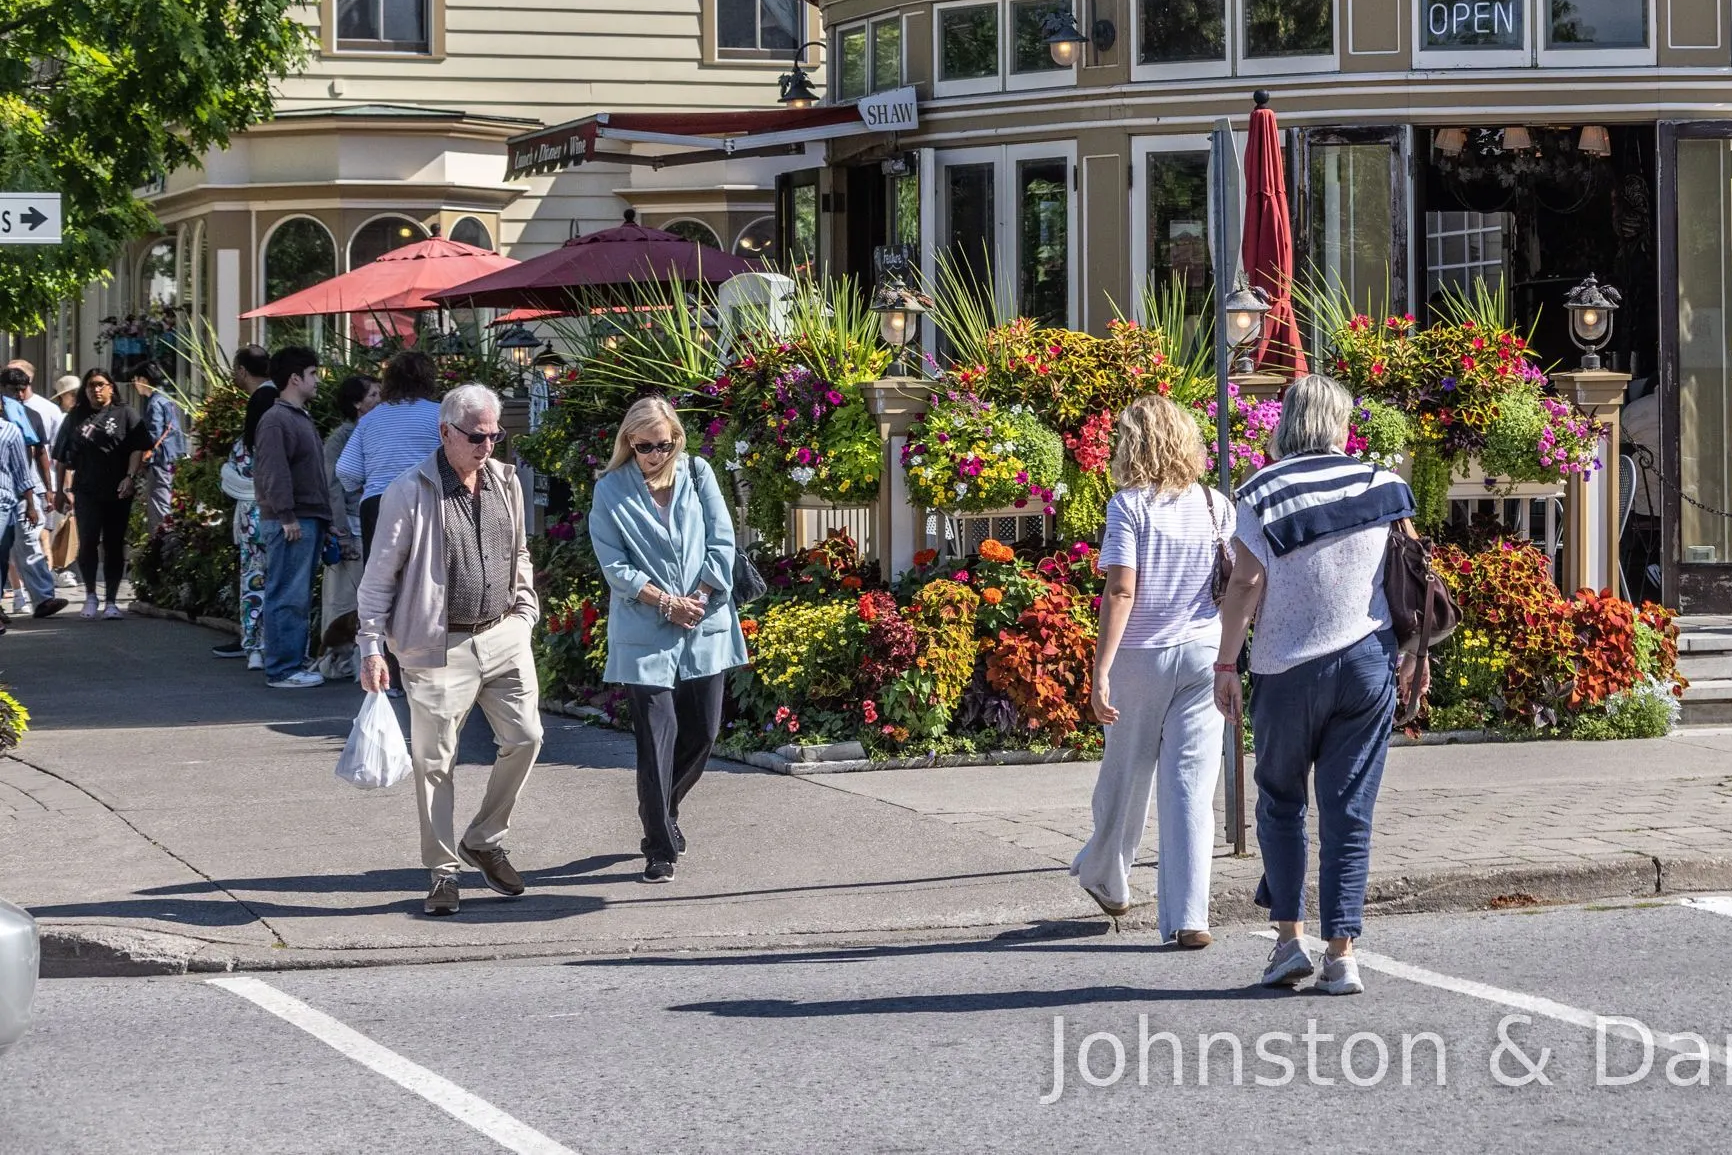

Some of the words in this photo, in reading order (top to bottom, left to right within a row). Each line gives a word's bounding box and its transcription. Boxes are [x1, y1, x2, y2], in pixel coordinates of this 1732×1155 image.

[1429, 1, 1513, 35] OPEN
[867, 103, 913, 125] SHAW
[538, 144, 562, 162] Dinner
[570, 136, 586, 156] Wine
